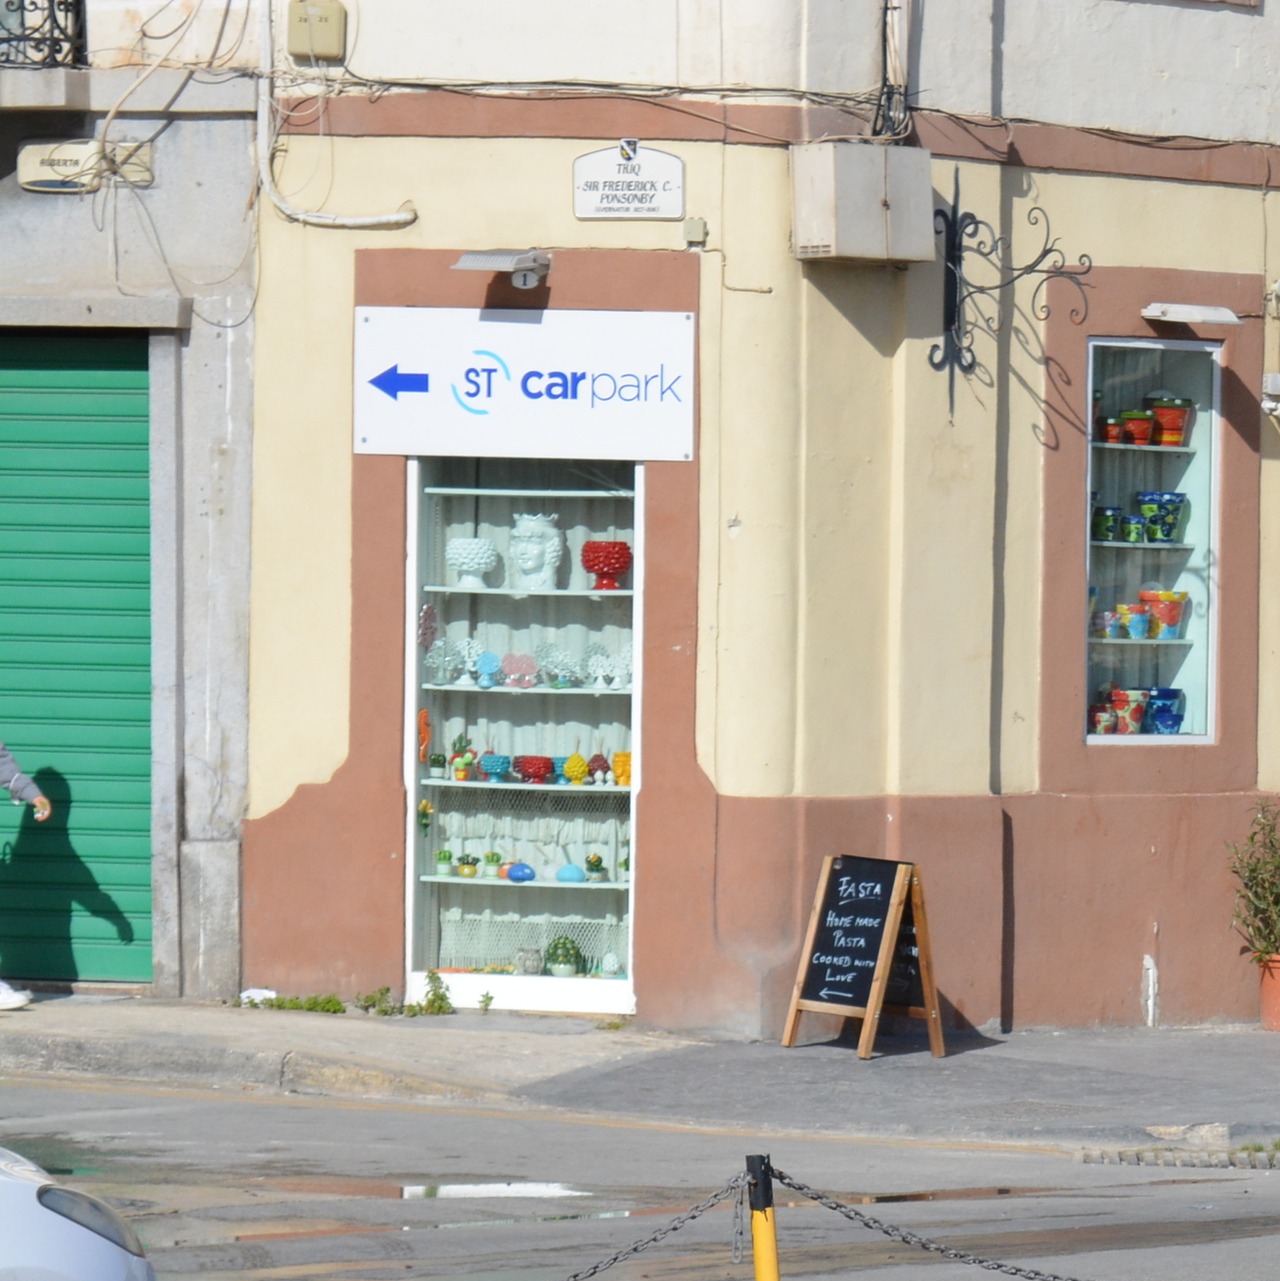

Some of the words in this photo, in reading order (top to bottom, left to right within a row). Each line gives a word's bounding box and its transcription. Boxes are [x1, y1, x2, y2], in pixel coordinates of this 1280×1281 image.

[616, 163, 641, 176] TRIQ
[582, 180, 599, 192] SIR
[602, 180, 657, 192] FREDERICK
[600, 193, 655, 204] PONSONBY
[521, 273, 528, 287] 1
[464, 368, 498, 398] ST
[832, 930, 866, 948] PASTA
[812, 953, 851, 967] COOKED
